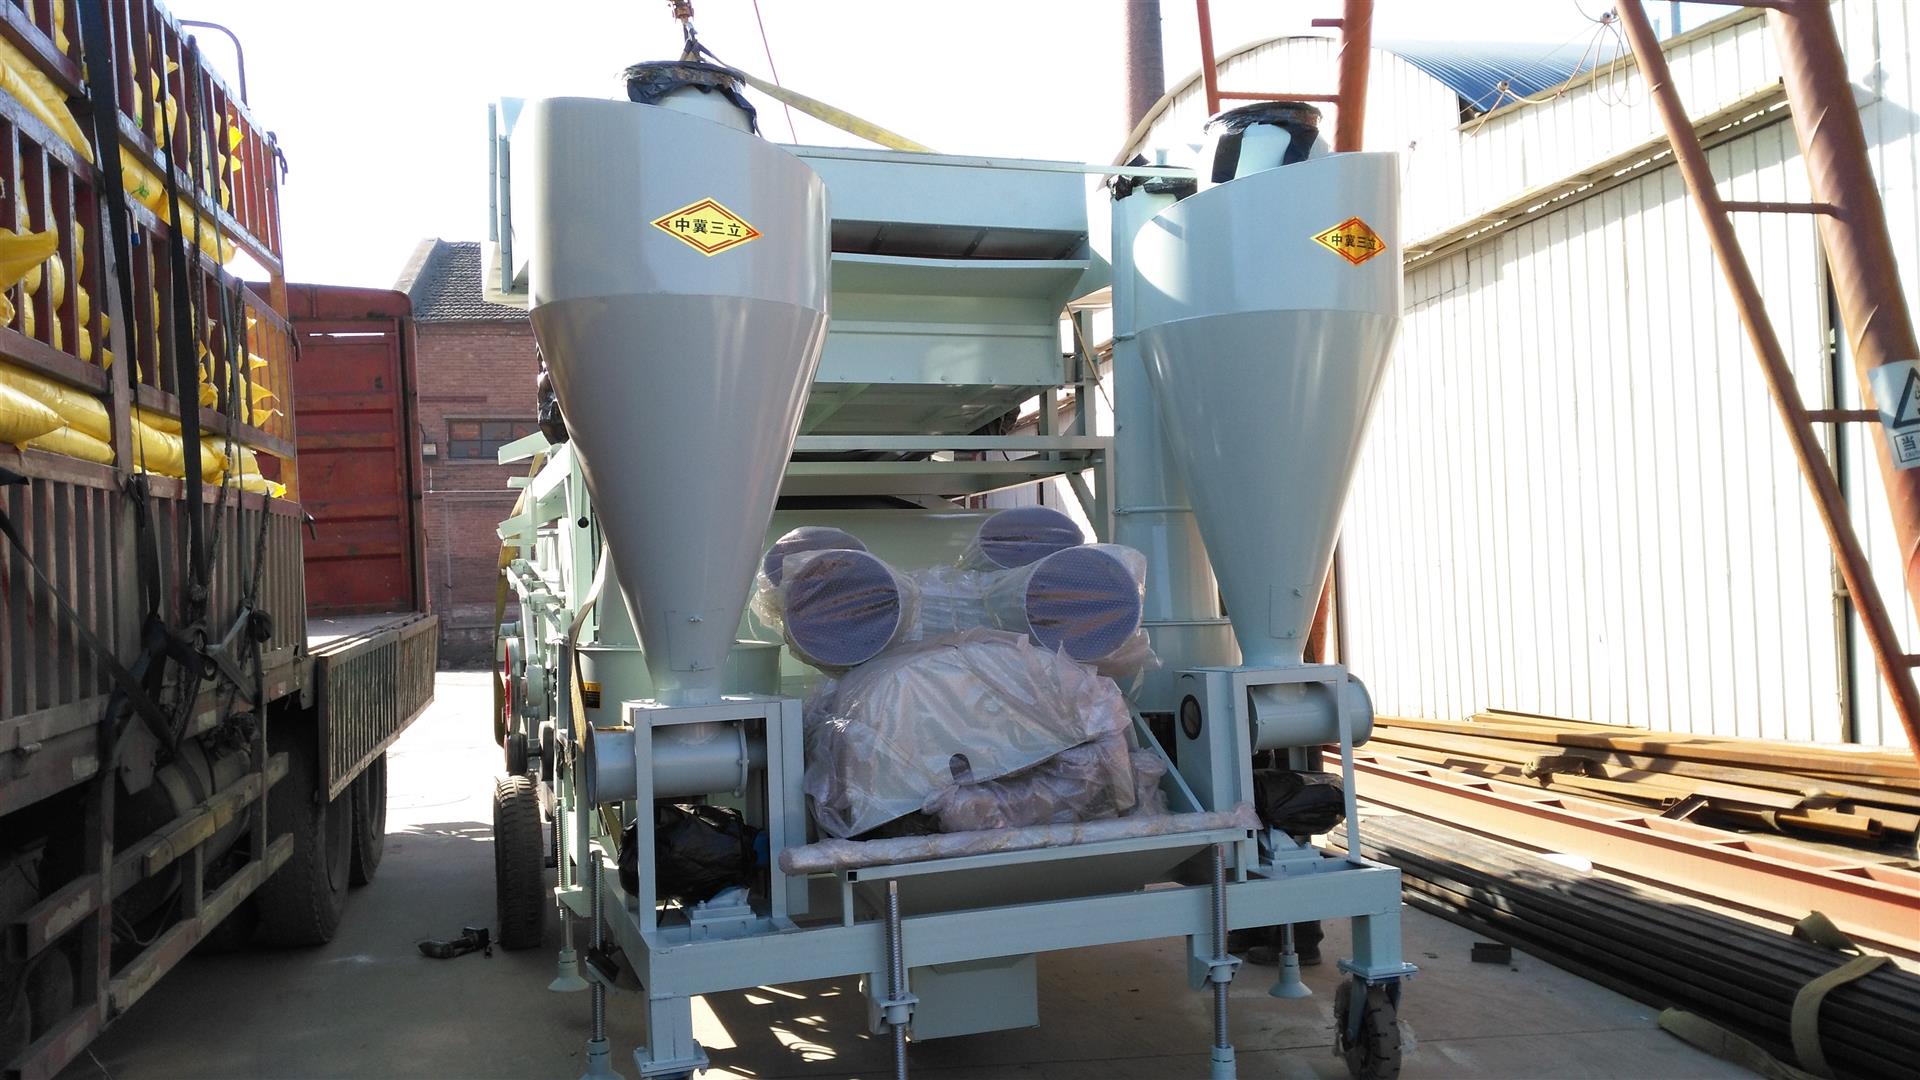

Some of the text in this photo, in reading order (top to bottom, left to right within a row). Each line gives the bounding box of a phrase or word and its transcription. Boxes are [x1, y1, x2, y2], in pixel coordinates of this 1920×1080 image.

[675, 217, 742, 238] 中冀三立
[1331, 233, 1377, 251] 中冀三立
